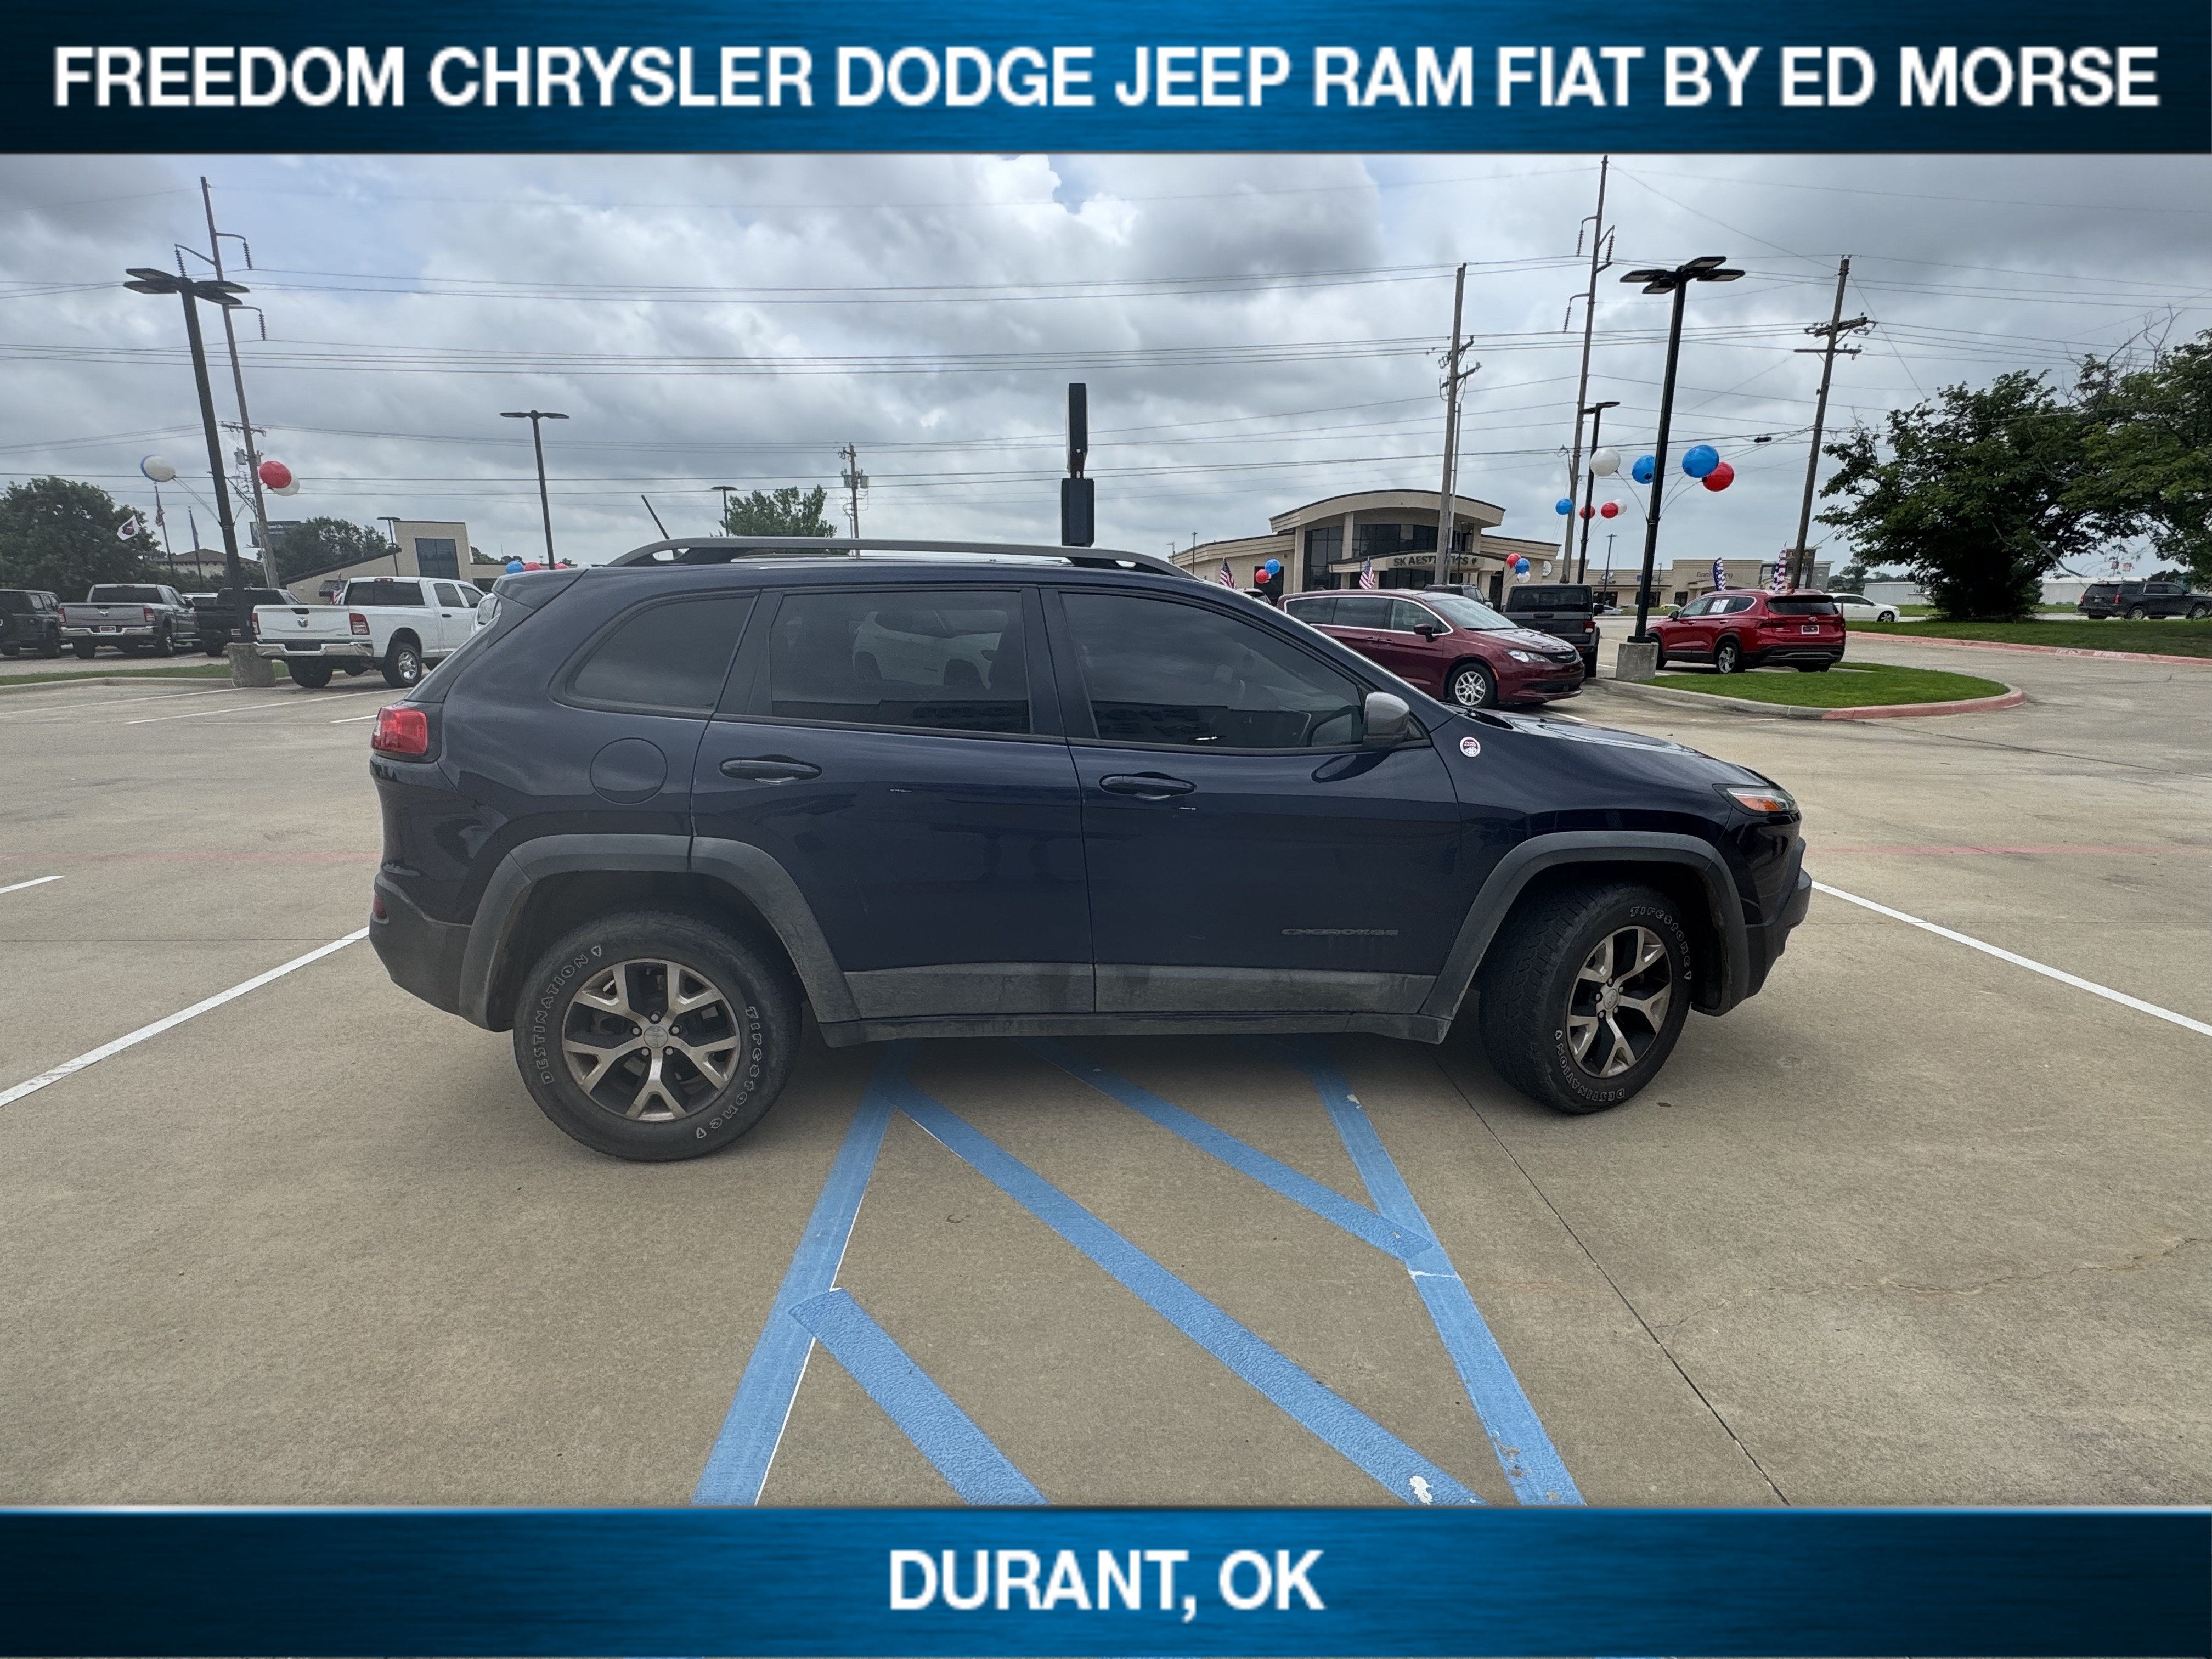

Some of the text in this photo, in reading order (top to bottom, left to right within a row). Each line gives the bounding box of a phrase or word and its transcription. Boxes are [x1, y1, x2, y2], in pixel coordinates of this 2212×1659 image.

[1393, 555, 1469, 566] SK AESTICS
[532, 954, 589, 1084] DESTINATION
[1556, 1042, 1625, 1103] DESTINATION
